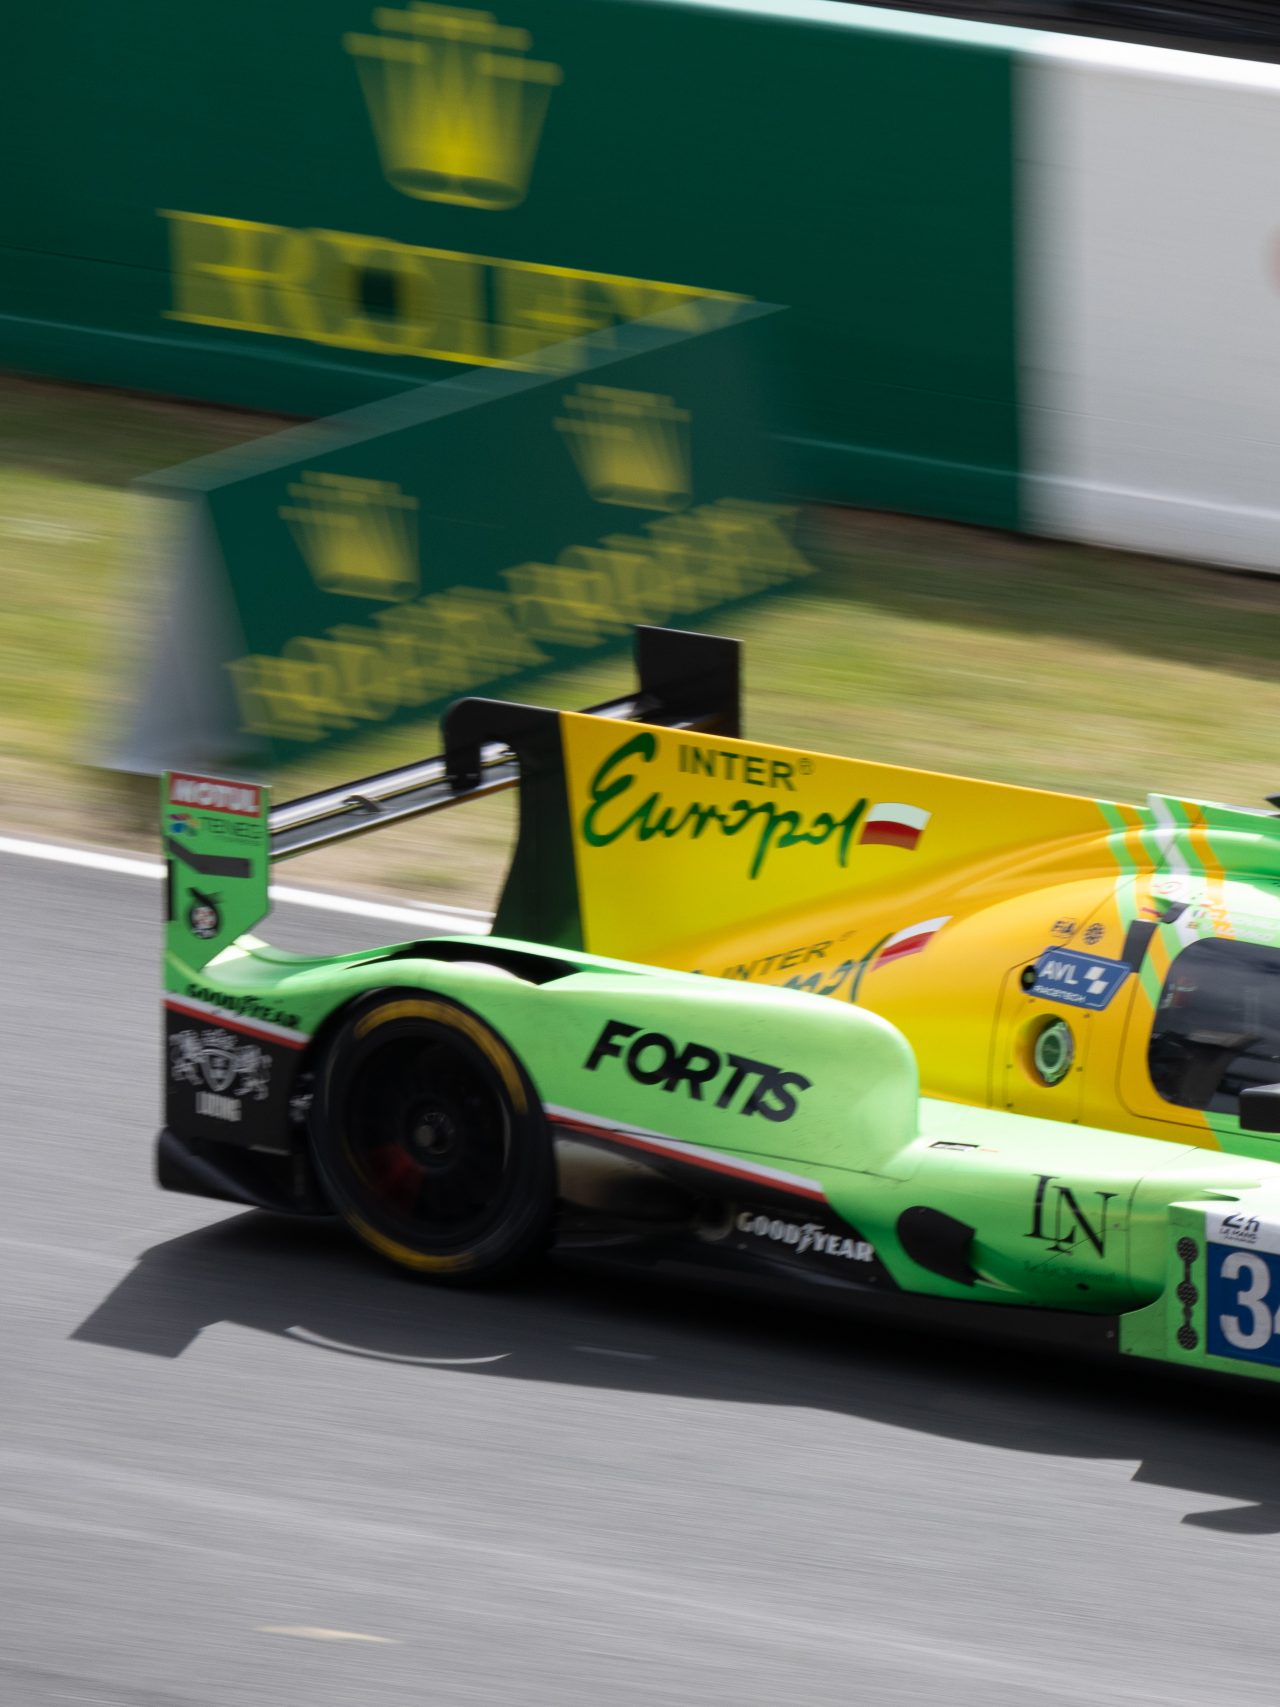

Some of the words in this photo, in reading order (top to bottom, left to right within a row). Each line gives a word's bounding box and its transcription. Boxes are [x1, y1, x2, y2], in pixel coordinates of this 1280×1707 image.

[582, 732, 870, 880] Europol
[1038, 960, 1080, 985] AVL
[584, 1019, 813, 1123] FORTIS
[736, 1210, 876, 1264] GOODYEAR
